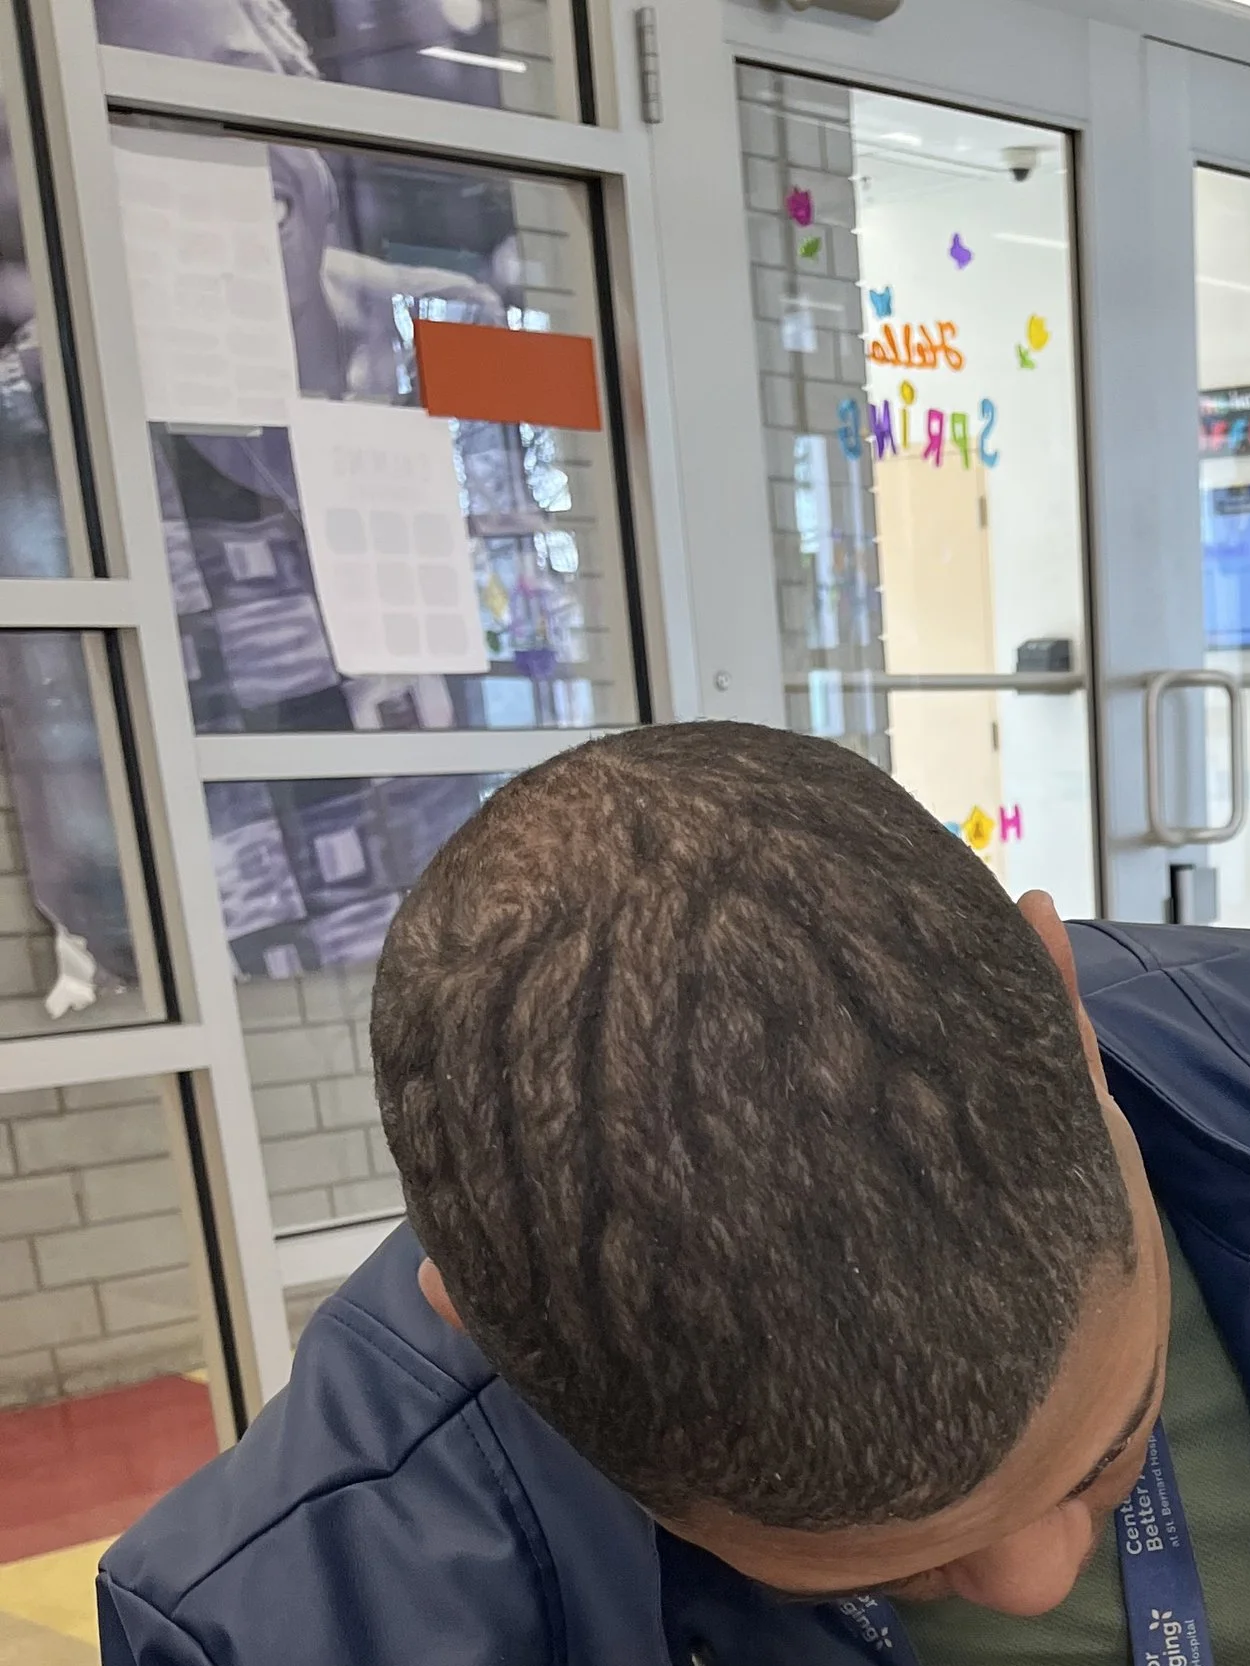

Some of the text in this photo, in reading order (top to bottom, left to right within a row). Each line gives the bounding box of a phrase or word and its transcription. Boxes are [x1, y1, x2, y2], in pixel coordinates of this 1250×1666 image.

[1136, 1486, 1164, 1551] Better
[1152, 1469, 1172, 1516] Bernard
[1120, 1495, 1143, 1555] Cent
[840, 1602, 878, 1642] ging
